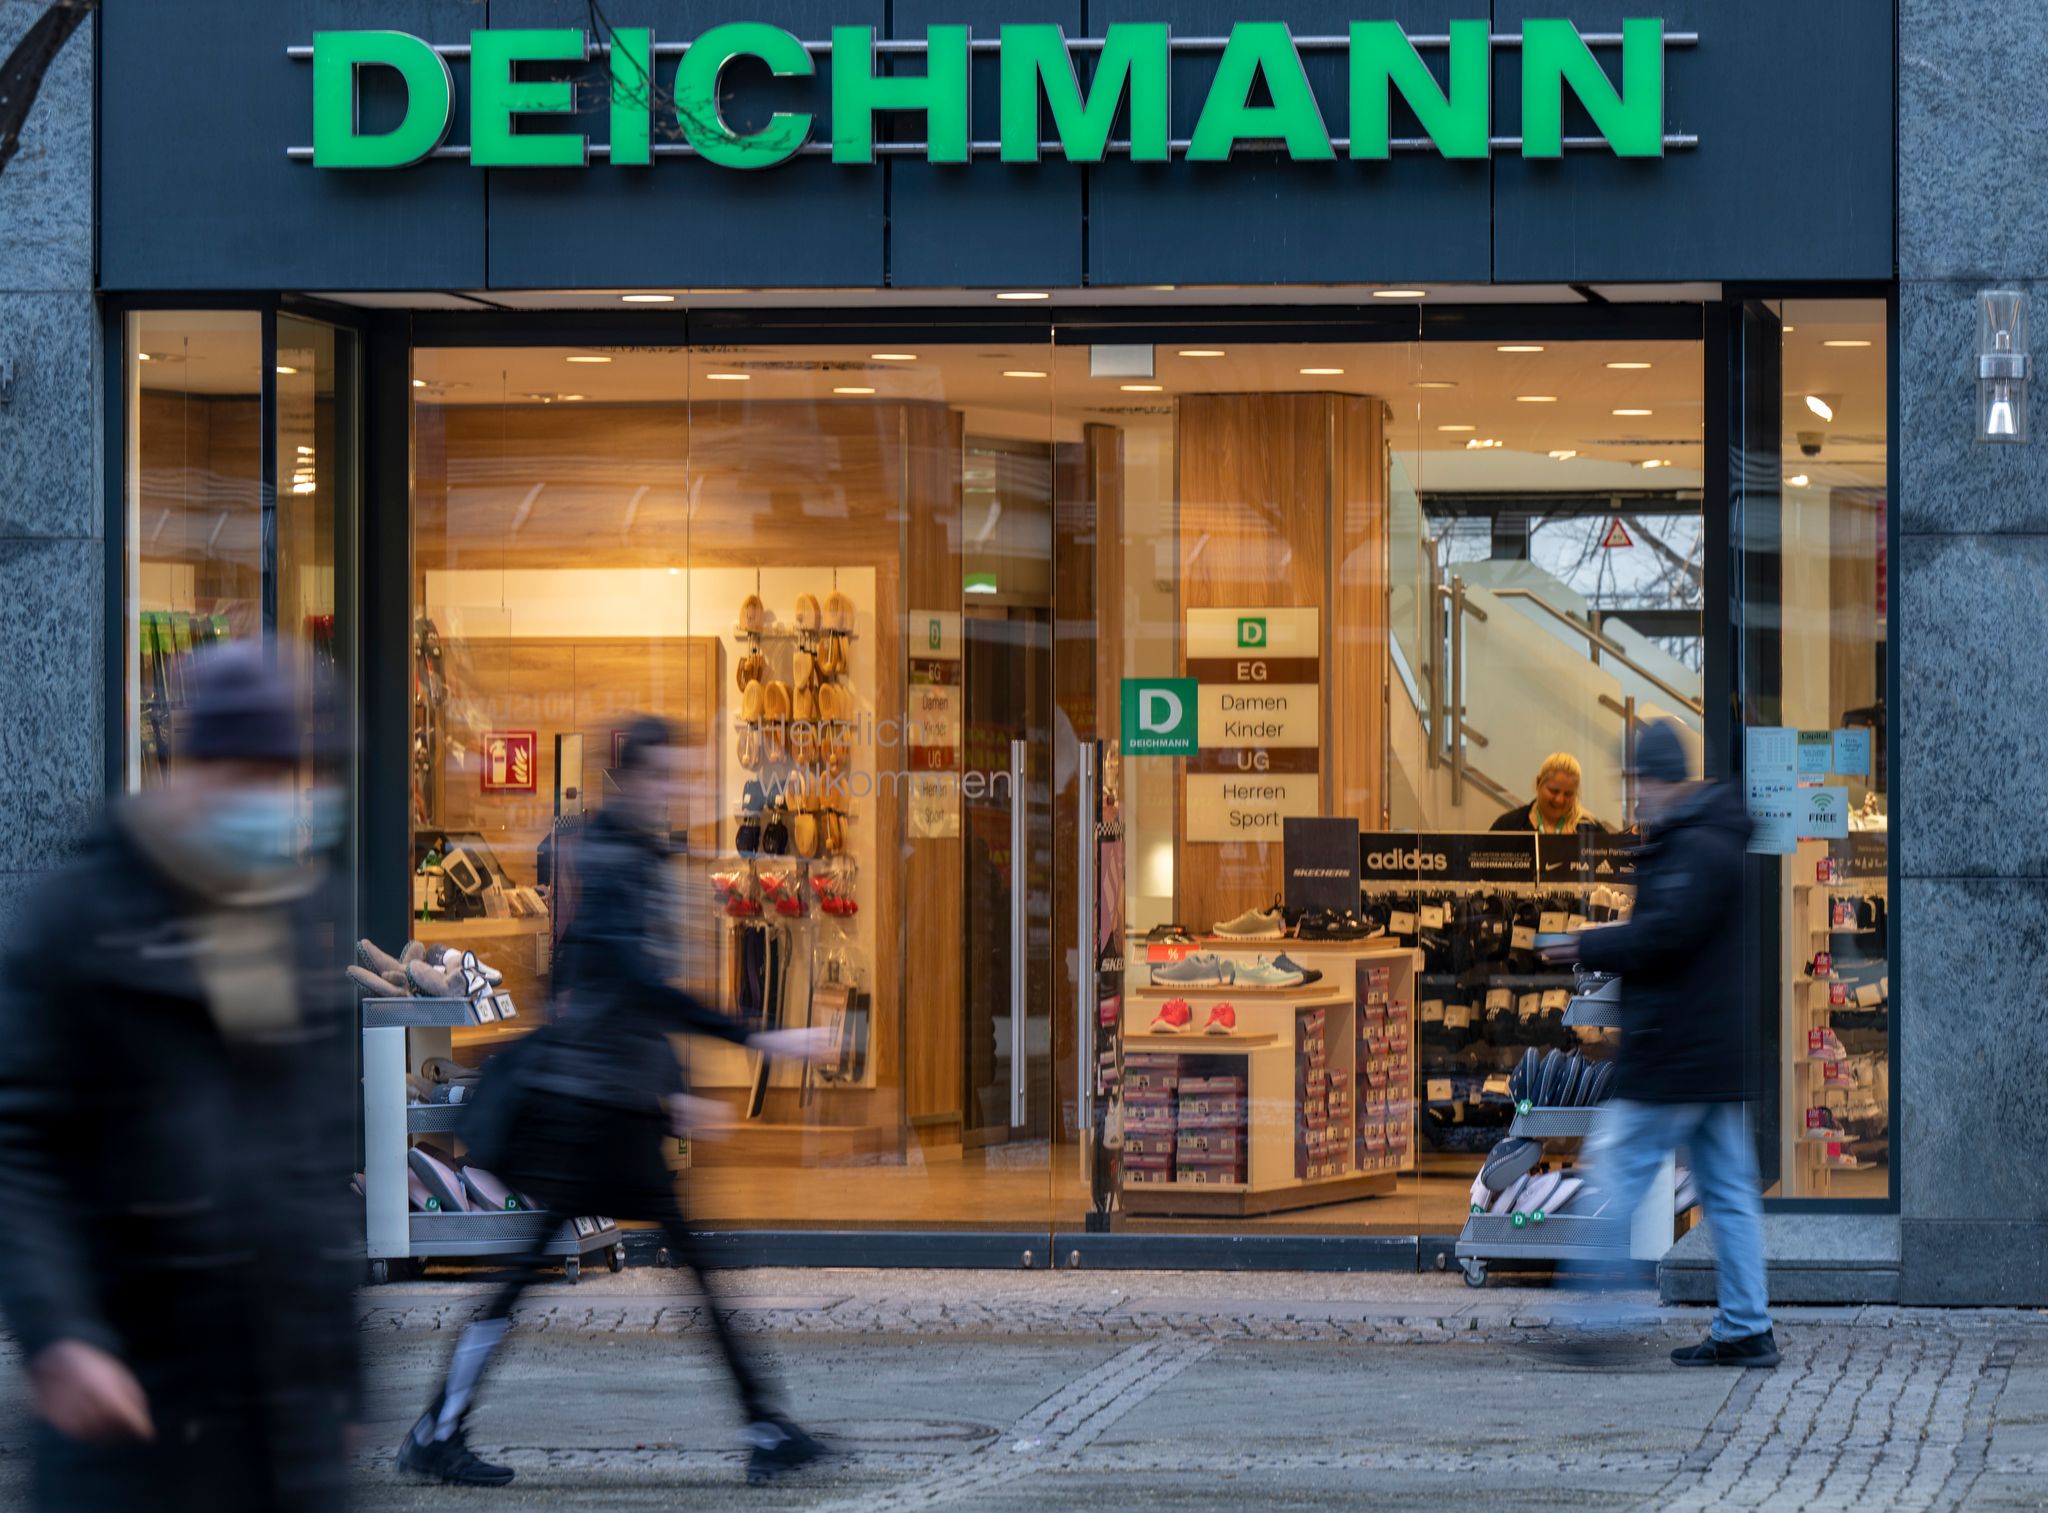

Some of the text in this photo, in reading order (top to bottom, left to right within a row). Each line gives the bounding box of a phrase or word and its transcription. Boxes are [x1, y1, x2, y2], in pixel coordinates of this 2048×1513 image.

[313, 18, 1664, 169] DEICHMANN
[1242, 622, 1262, 643] D
[929, 663, 941, 681] EG
[1237, 661, 1267, 681] EG
[922, 695, 949, 711] Damen
[1140, 688, 1183, 734] D
[1221, 694, 1287, 711] Damen
[757, 711, 926, 748] Herzlich
[1225, 721, 1283, 738] Kinder
[1129, 738, 1189, 748] DEICHMANN
[928, 751, 942, 768] UG
[1237, 752, 1270, 770] UG
[759, 762, 1012, 798] willkommen
[1223, 784, 1286, 800] Herren
[925, 808, 944, 825] Sport
[1229, 811, 1279, 829] Sport
[1808, 813, 1837, 823] FREE
[1367, 847, 1447, 871] adidas
[1470, 861, 1530, 869] DEICHMANN.COM
[1293, 868, 1350, 878] SKECHERS
